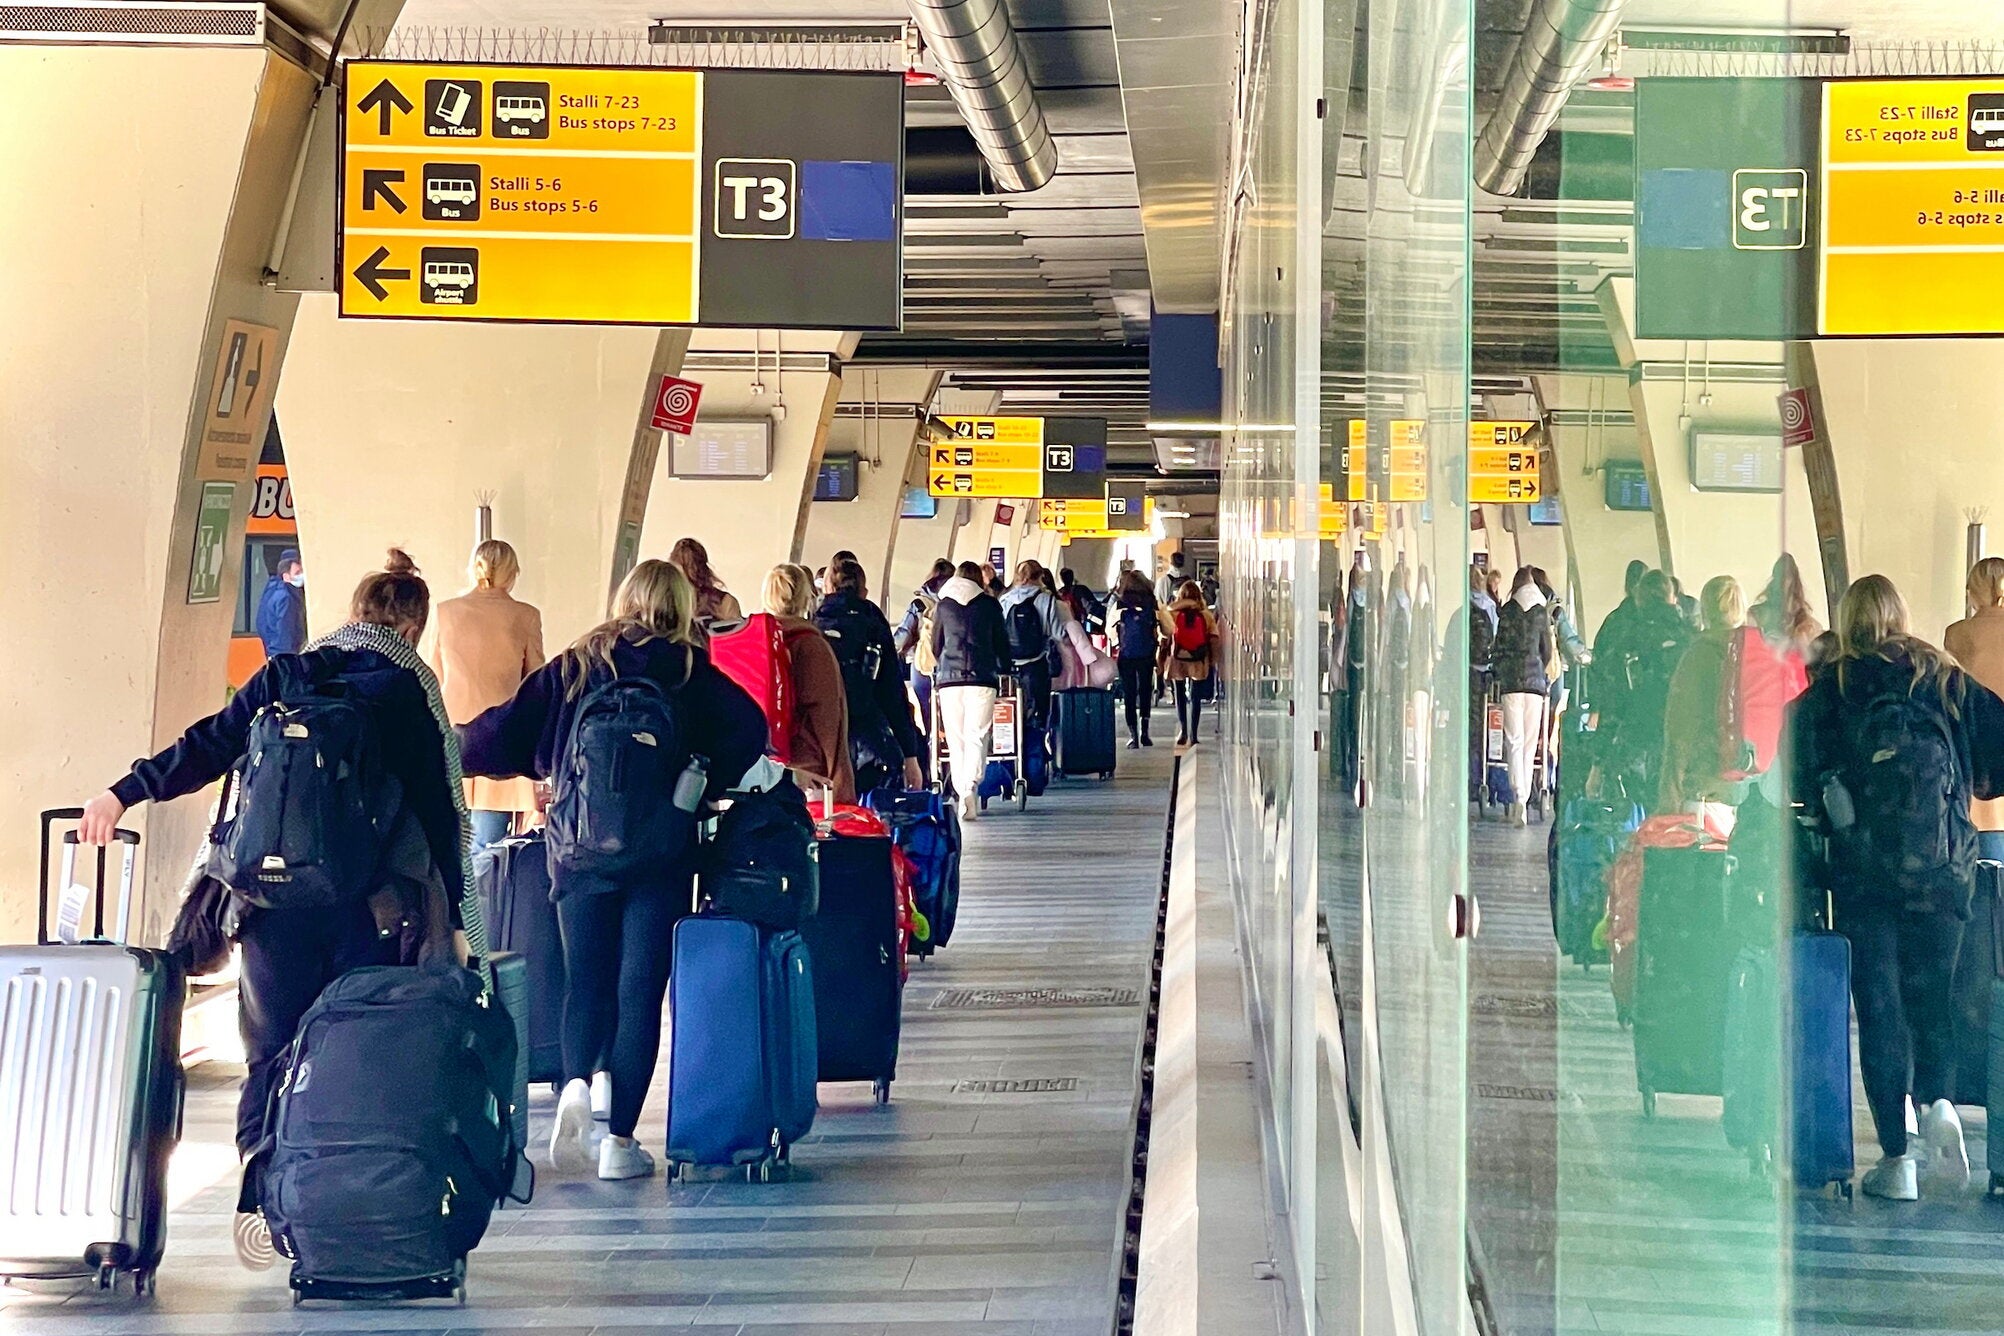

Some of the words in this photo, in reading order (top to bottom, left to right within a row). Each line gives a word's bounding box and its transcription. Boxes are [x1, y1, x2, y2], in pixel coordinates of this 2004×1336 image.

[559, 94, 598, 108] Stalli
[604, 96, 639, 109] 7-23
[429, 126, 447, 135] Bus
[448, 126, 477, 136] Ticket
[510, 125, 530, 136] Bus
[559, 116, 588, 129] Bus
[593, 117, 636, 133] stops
[641, 117, 676, 130] 7-23
[490, 177, 529, 191] Stalli
[535, 178, 561, 191] 5-6
[490, 198, 519, 211] Bus
[524, 200, 567, 215] stops
[572, 200, 598, 213] 5-6
[723, 177, 787, 221] T3
[441, 208, 461, 217] Bus
[1049, 450, 1071, 466] T3
